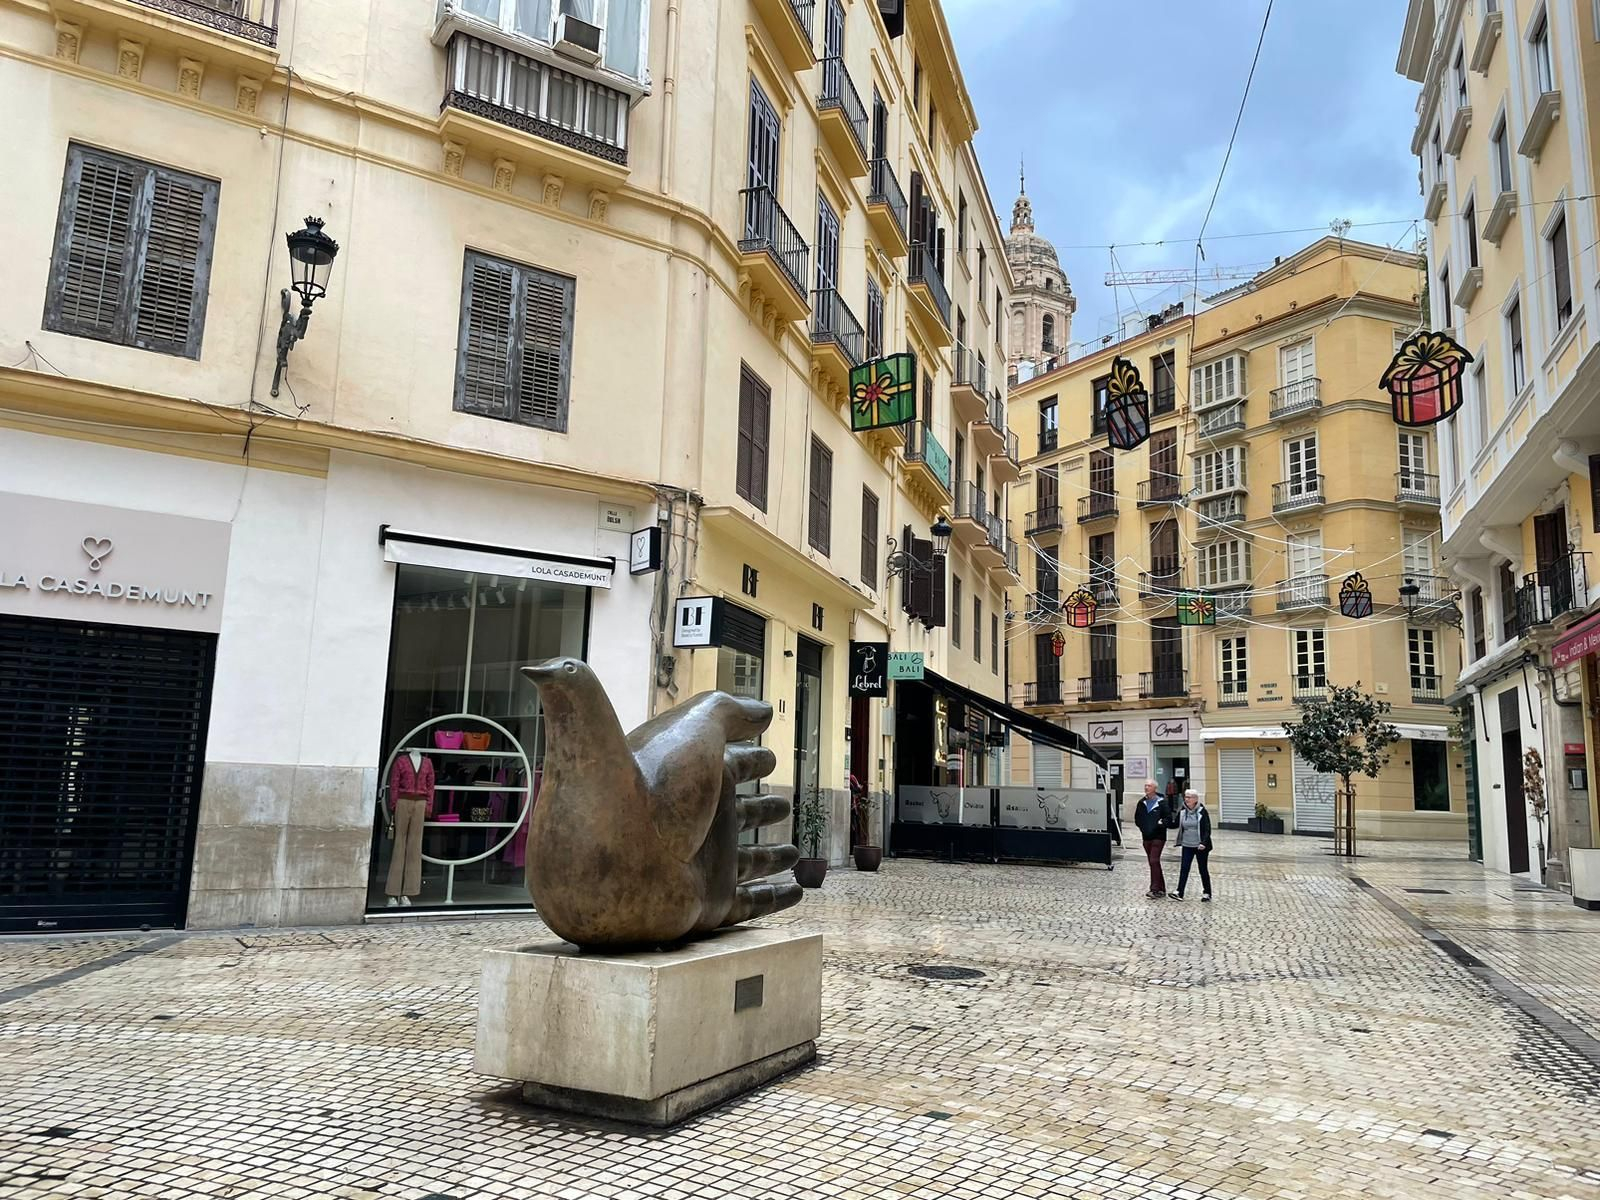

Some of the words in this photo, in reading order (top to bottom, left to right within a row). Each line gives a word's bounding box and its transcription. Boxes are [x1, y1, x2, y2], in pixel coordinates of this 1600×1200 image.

[531, 566, 552, 575] LOLA
[553, 569, 607, 582] CASADEMUNT
[38, 574, 213, 608] CASADEMUNT
[899, 665, 920, 673] BALI
[852, 674, 882, 692] Lebrel
